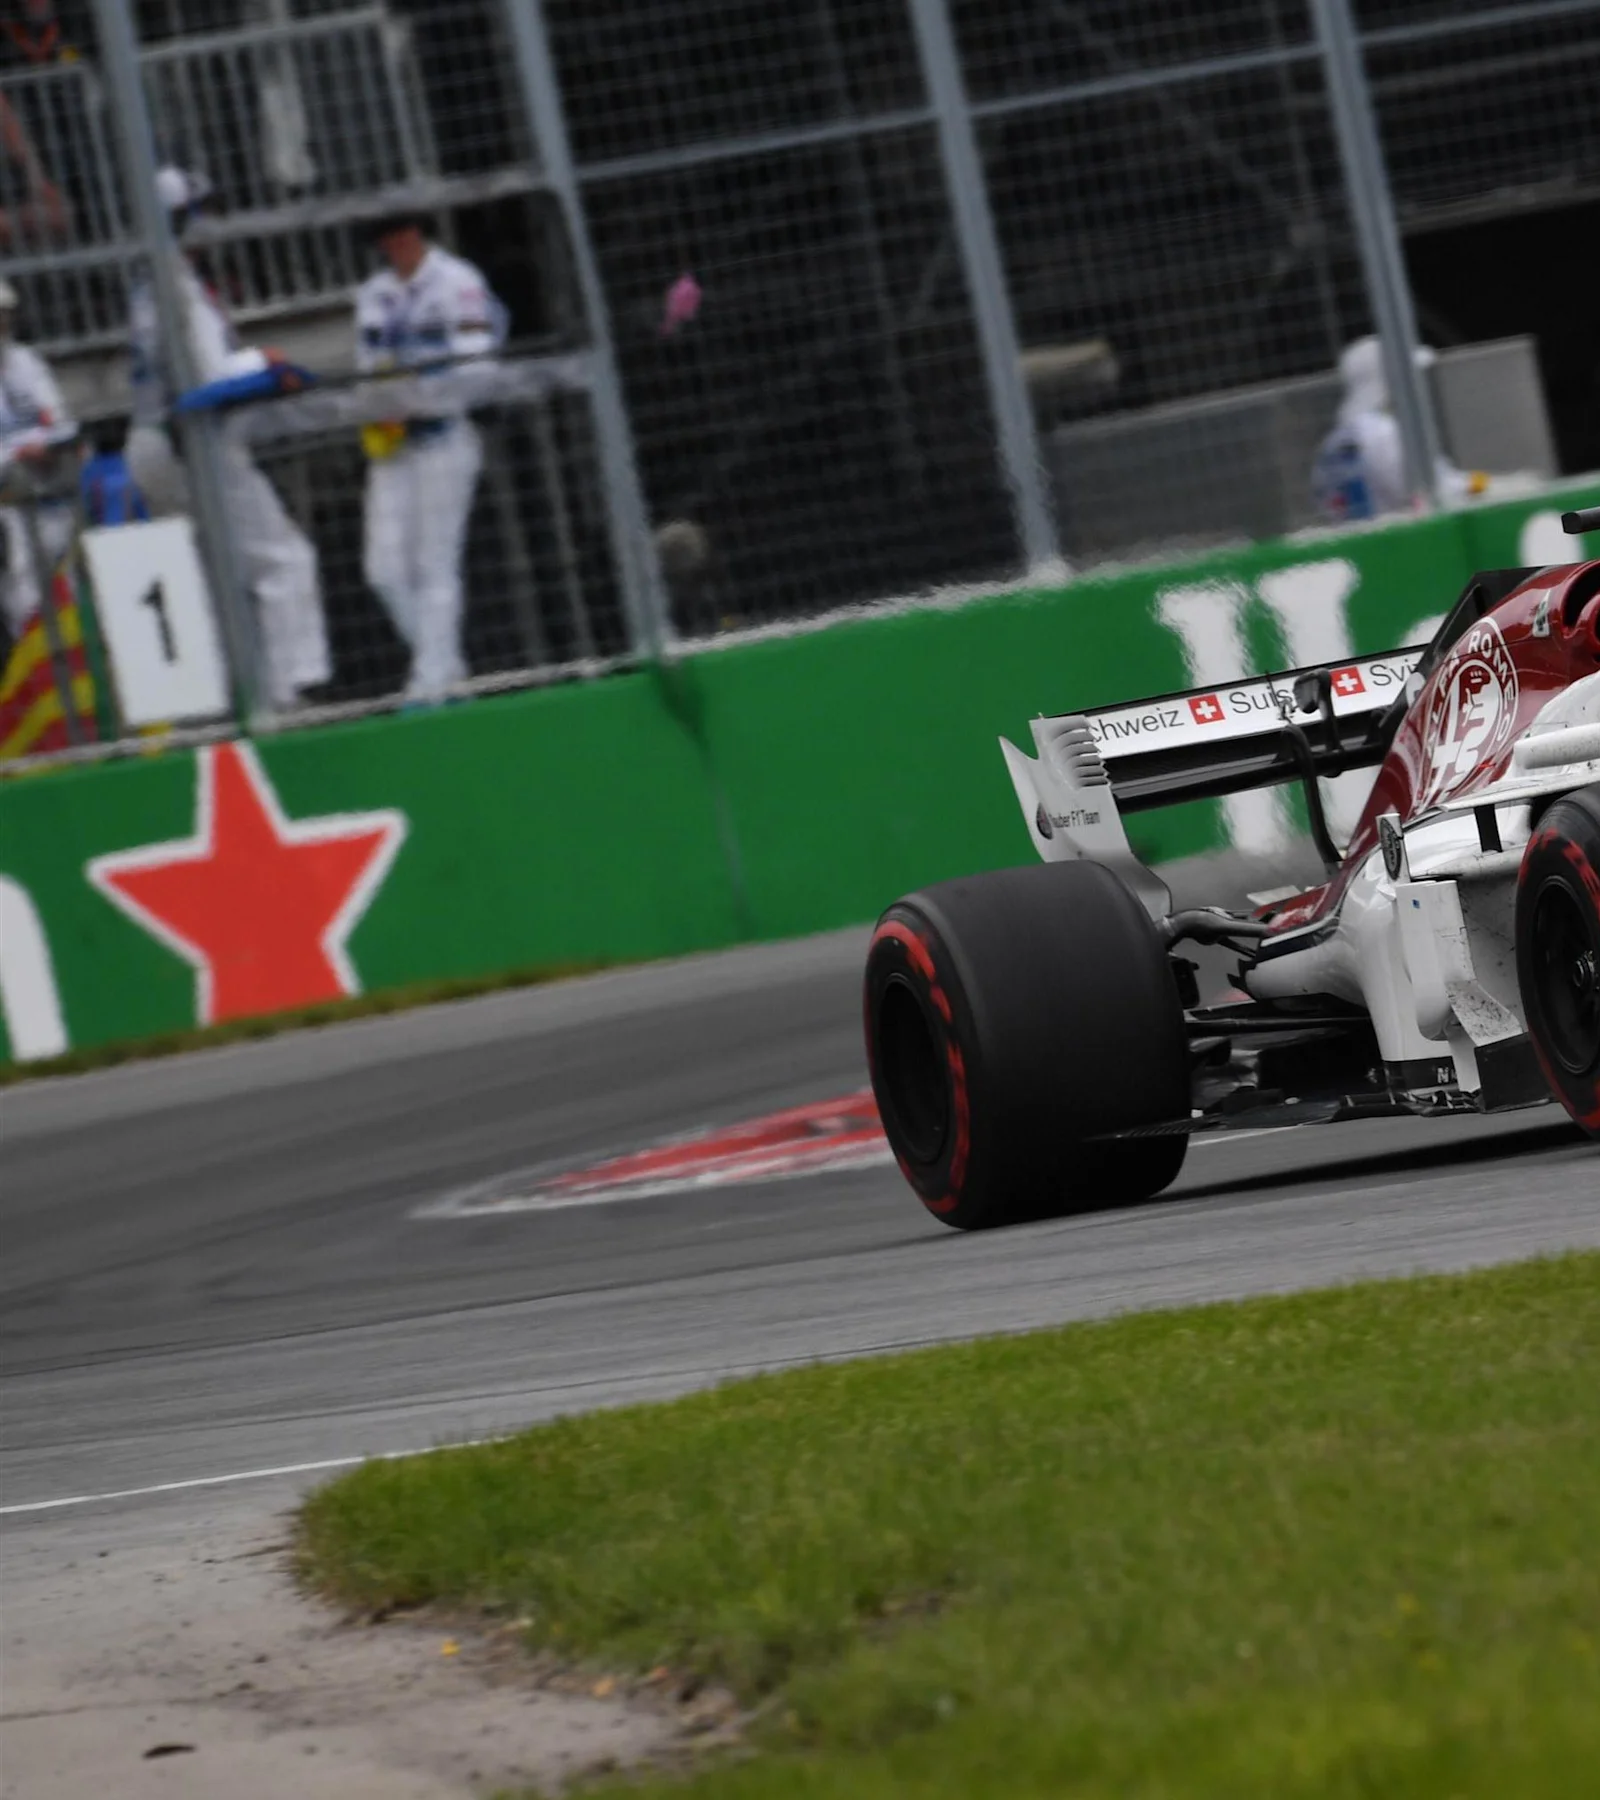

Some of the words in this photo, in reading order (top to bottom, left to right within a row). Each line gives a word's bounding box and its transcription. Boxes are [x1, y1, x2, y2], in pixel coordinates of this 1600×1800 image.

[139, 576, 178, 666] 1
[1369, 658, 1418, 686] Svi
[1468, 629, 1514, 742] ROMEO
[1228, 686, 1294, 714] Suis
[1092, 708, 1184, 743] chweiz
